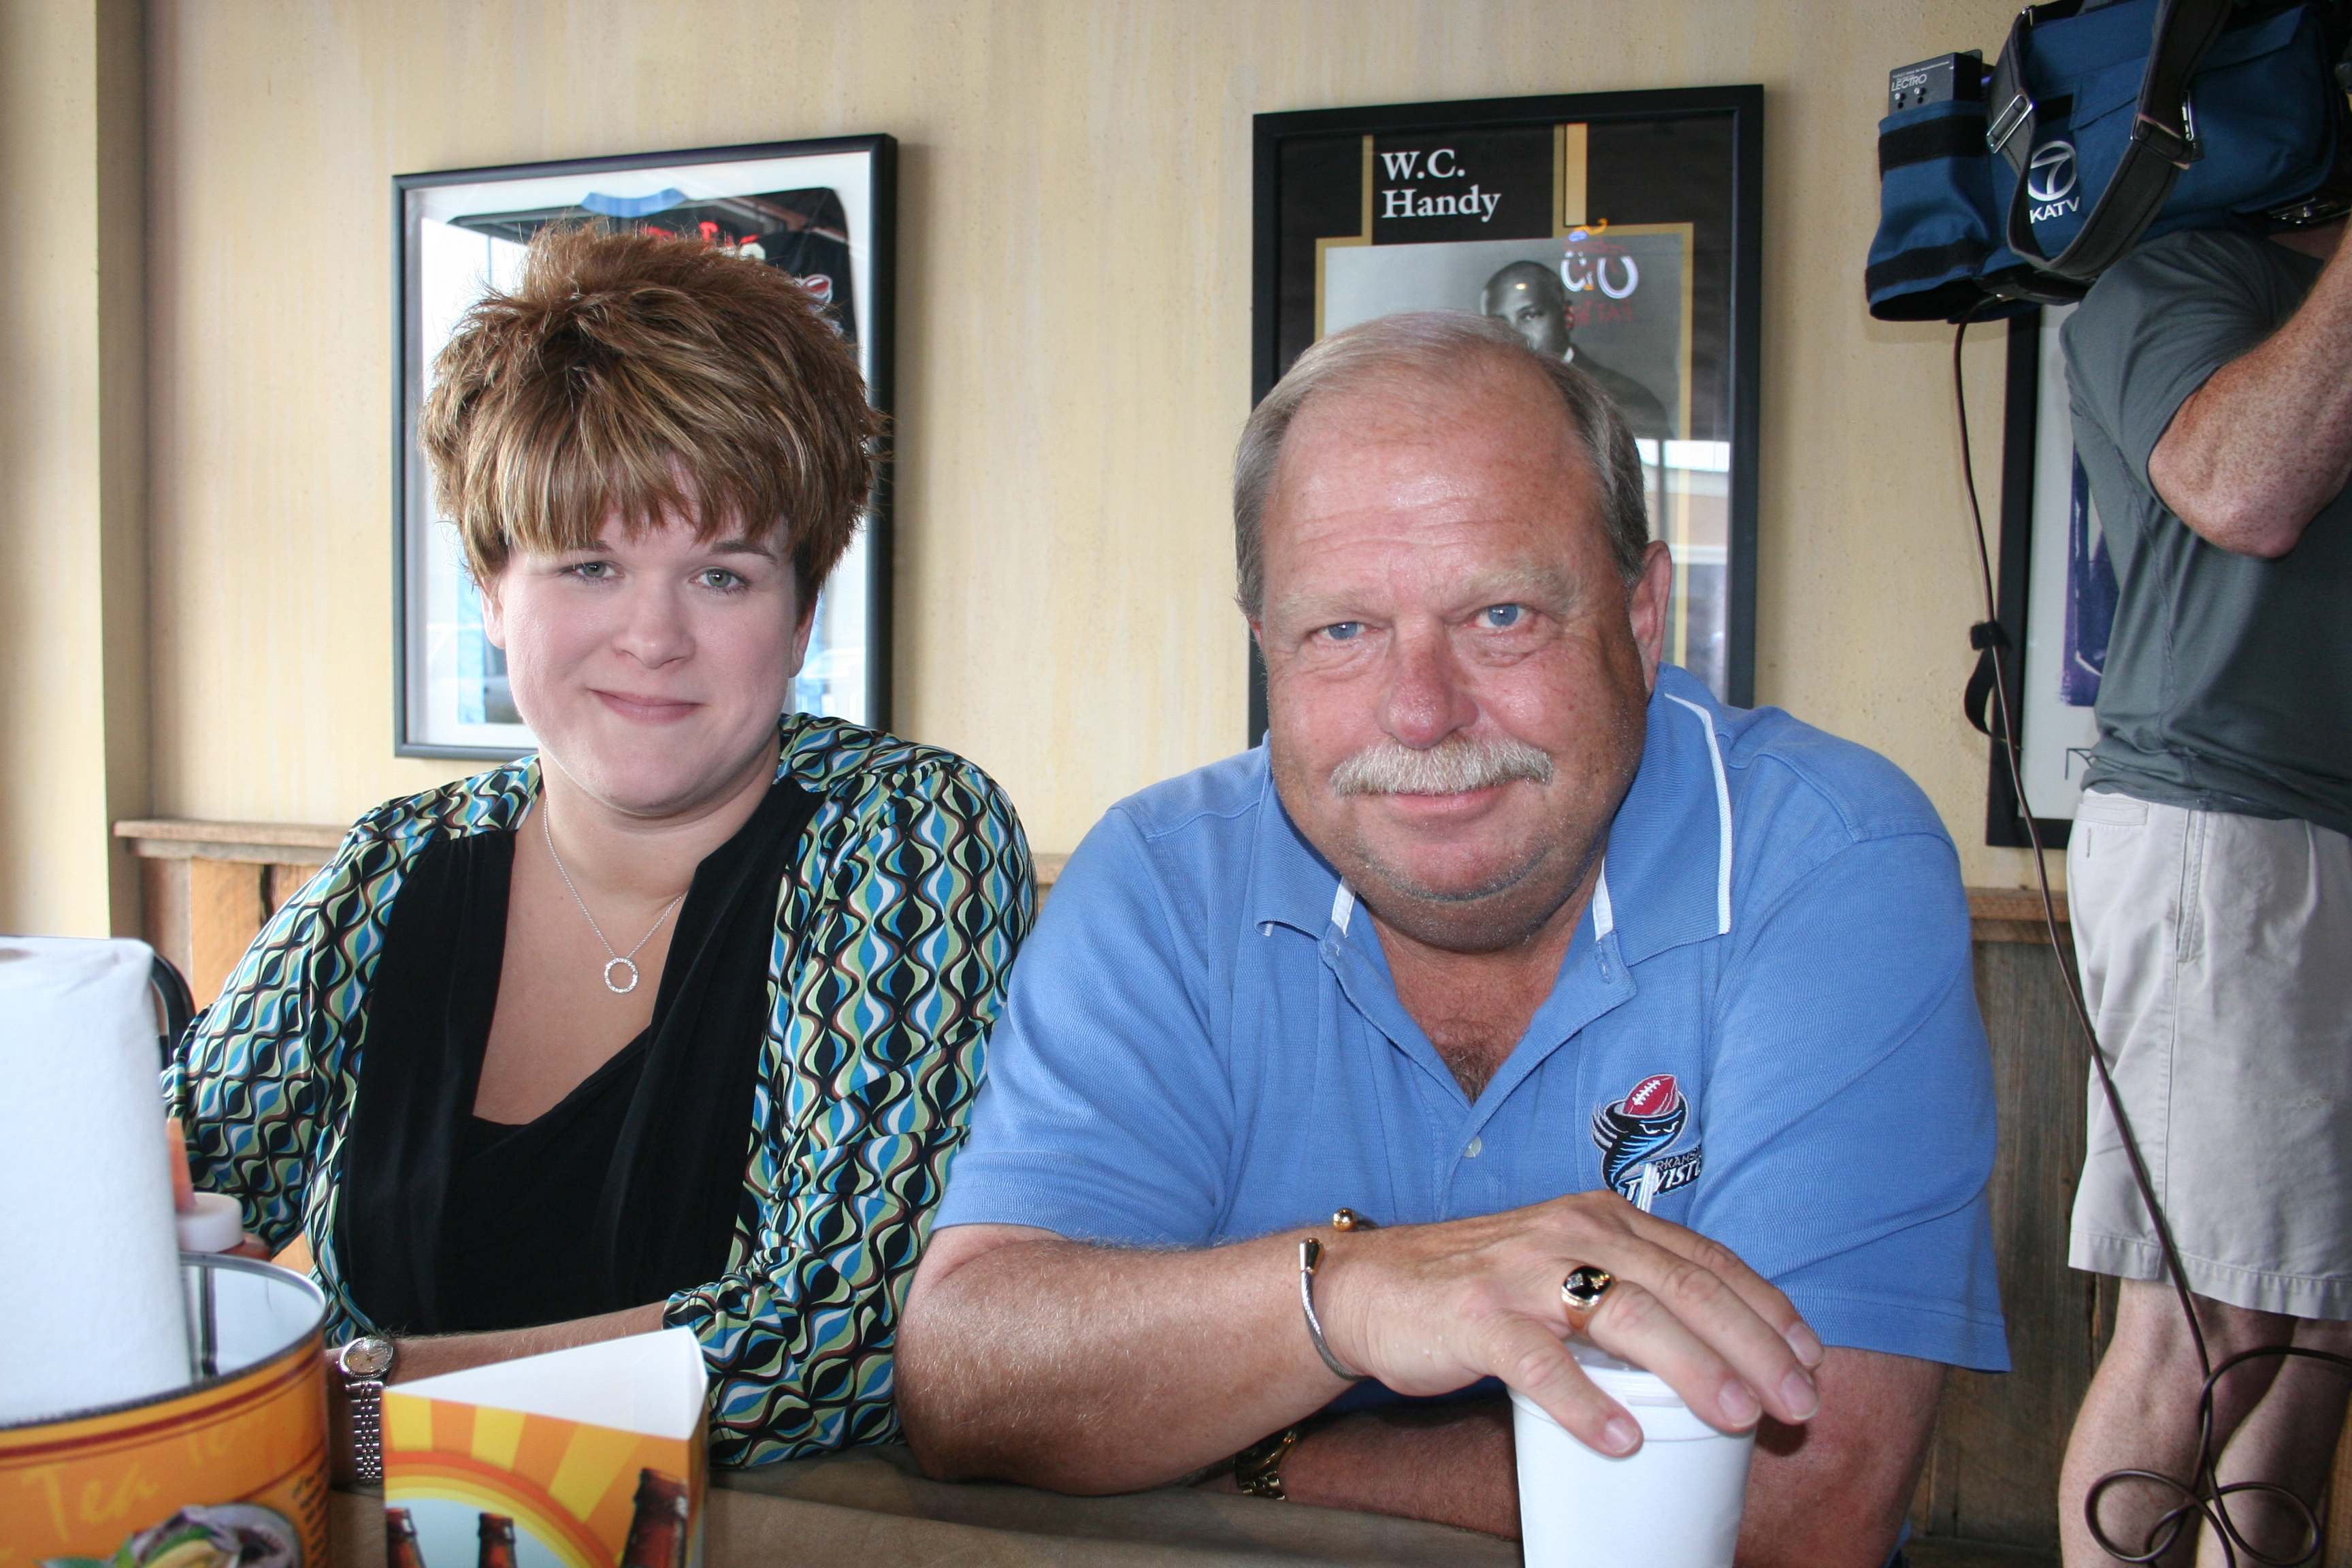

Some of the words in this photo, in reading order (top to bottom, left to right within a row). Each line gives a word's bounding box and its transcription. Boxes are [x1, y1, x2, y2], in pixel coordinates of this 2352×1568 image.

[1891, 74, 1927, 92] LECTRO
[1381, 148, 1466, 181] W.C.
[1381, 184, 1503, 223] Handy
[2029, 196, 2080, 224] KATV
